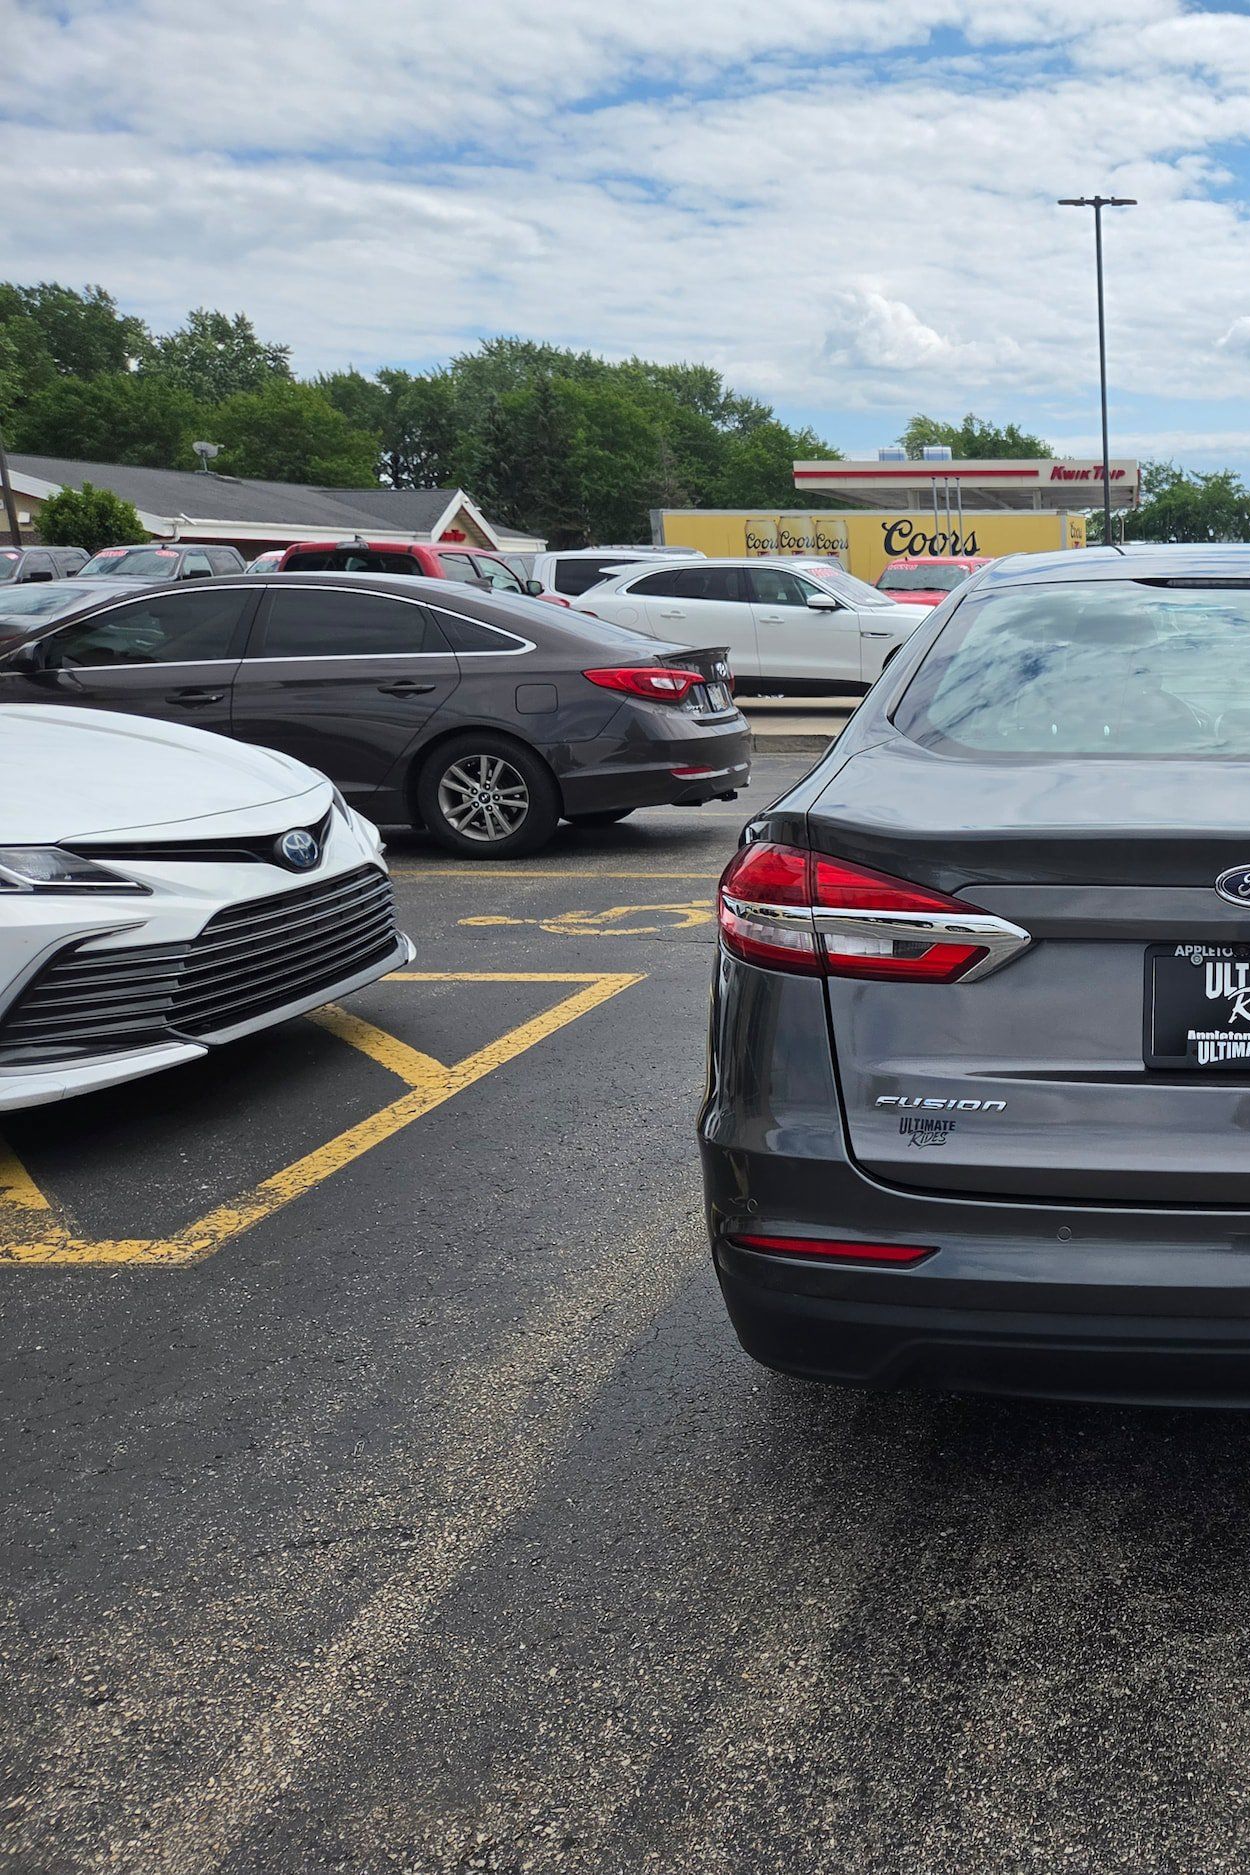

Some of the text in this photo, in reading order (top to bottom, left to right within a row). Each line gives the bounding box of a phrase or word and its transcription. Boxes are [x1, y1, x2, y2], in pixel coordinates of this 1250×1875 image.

[1051, 466, 1092, 480] KWIK
[881, 519, 980, 556] Coors
[1175, 945, 1248, 957] APPLETO
[875, 1095, 1008, 1113] FUSION
[899, 1117, 958, 1136] ULTIMATE
